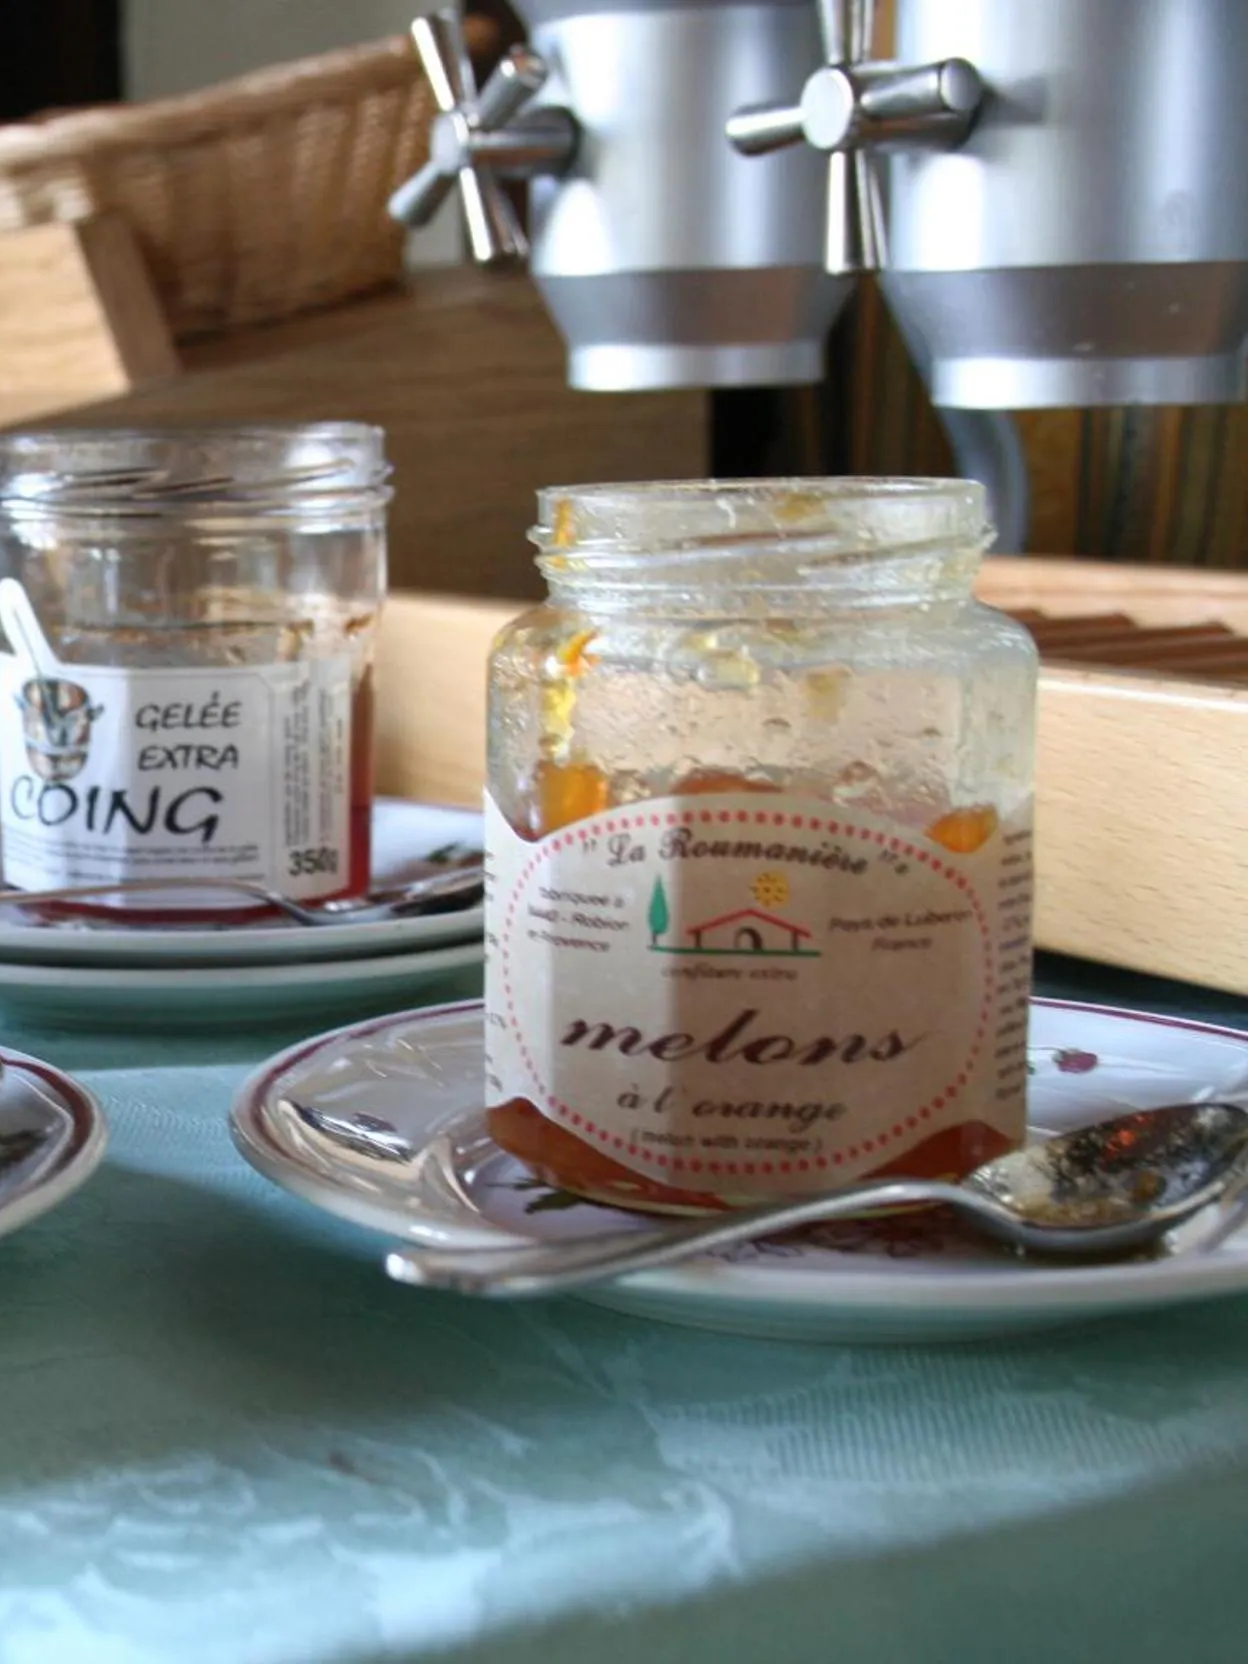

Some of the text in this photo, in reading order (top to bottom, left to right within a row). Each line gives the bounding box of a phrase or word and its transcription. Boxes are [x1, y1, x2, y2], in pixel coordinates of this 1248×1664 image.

[135, 692, 242, 731] GELÉE
[138, 744, 239, 772] EXTRA
[10, 774, 223, 843] COING
[560, 1009, 924, 1067] melons
[691, 1100, 848, 1133] orange
